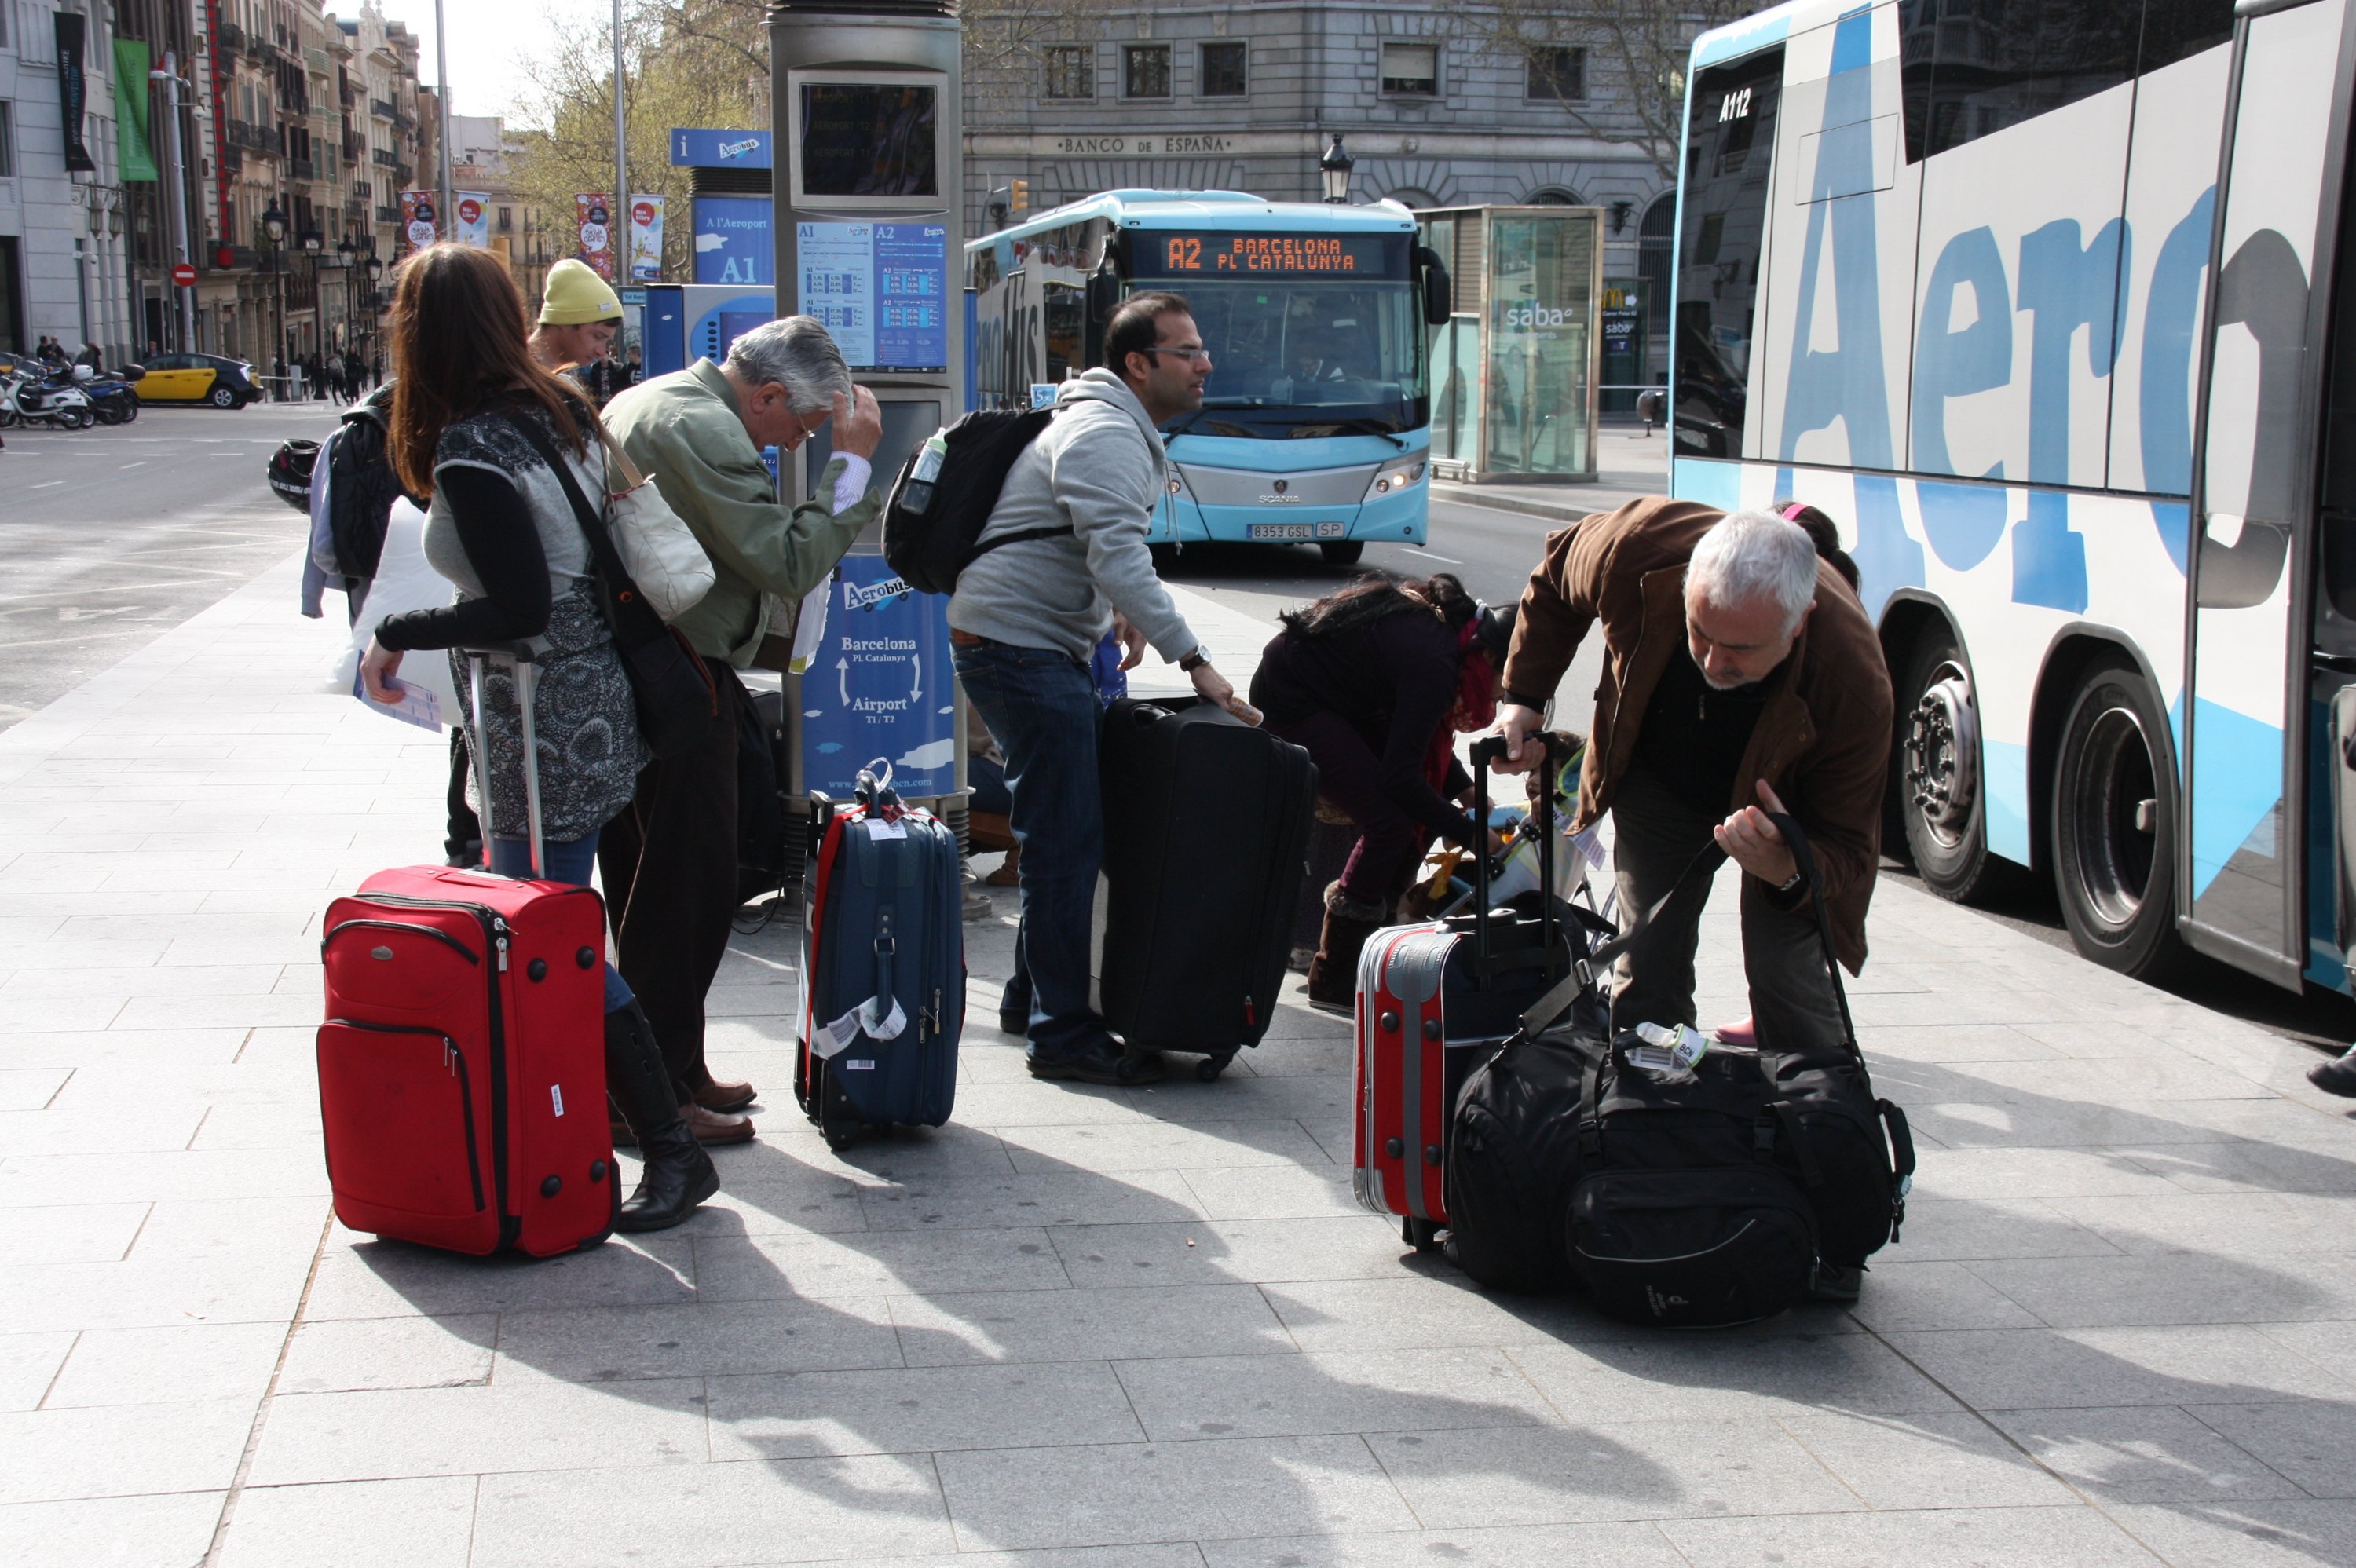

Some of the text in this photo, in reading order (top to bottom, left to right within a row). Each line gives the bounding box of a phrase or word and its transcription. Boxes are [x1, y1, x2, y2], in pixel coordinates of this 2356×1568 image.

[1718, 87, 1751, 123] A112
[1065, 136, 1224, 152] BANCO DE ESPAÑA
[706, 217, 767, 229] A l'Aeroport
[799, 225, 814, 237] A1
[876, 226, 894, 239] A2
[1169, 238, 1202, 269] A2
[1233, 239, 1341, 254] BARCELONA
[719, 256, 757, 283] A1
[1218, 254, 1354, 270] PL CATALUNYA
[1506, 302, 1564, 327] saba
[1605, 321, 1631, 334] saba
[1254, 525, 1309, 538] 8353 GSL
[1320, 524, 1341, 536] SP
[841, 636, 916, 651] Barcelona
[852, 654, 906, 663] Pl. Catalunya
[852, 696, 907, 714] Airport
[865, 715, 876, 724] T1
[883, 715, 895, 724] T2
[1678, 1043, 1695, 1058] BCN
